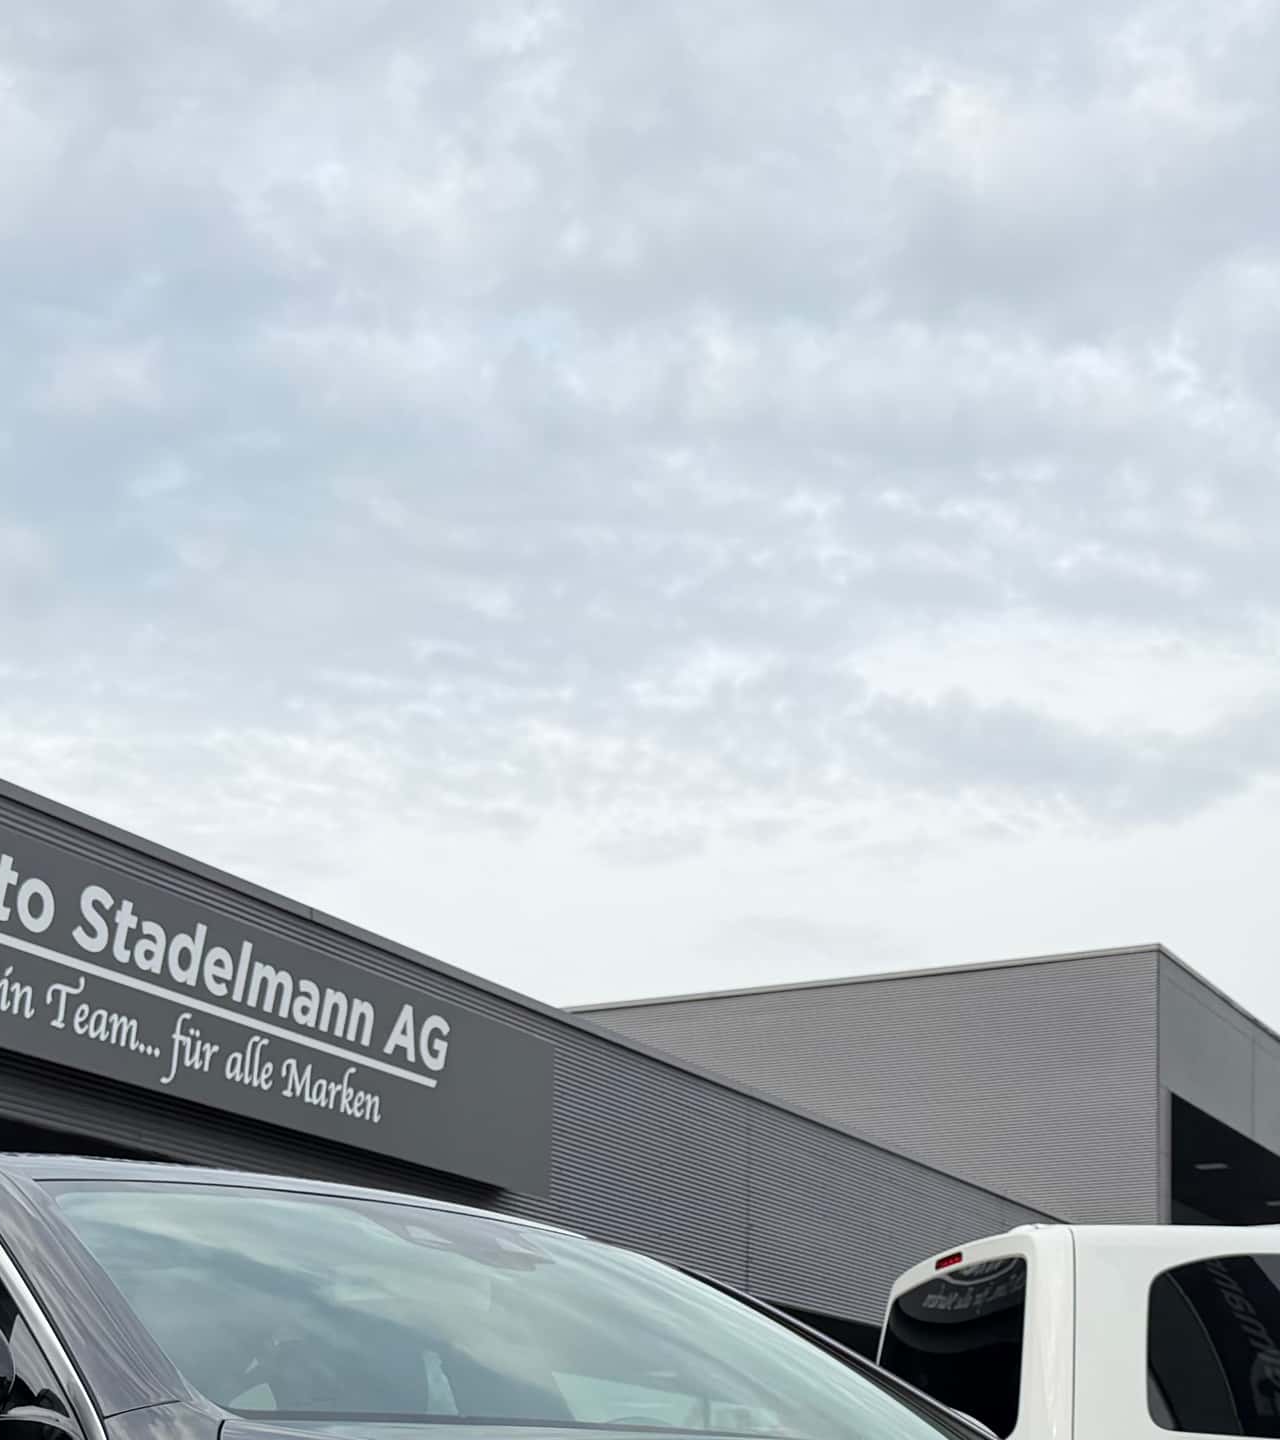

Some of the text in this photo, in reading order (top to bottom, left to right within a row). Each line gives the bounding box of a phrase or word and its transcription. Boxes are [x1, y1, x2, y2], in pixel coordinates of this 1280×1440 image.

[47, 976, 160, 1058] Team...
[160, 1012, 218, 1083] für
[225, 1036, 274, 1090] alle
[281, 1057, 382, 1123] Marken
[72, 885, 374, 1047] Stadelmann
[383, 1003, 450, 1071] AG
